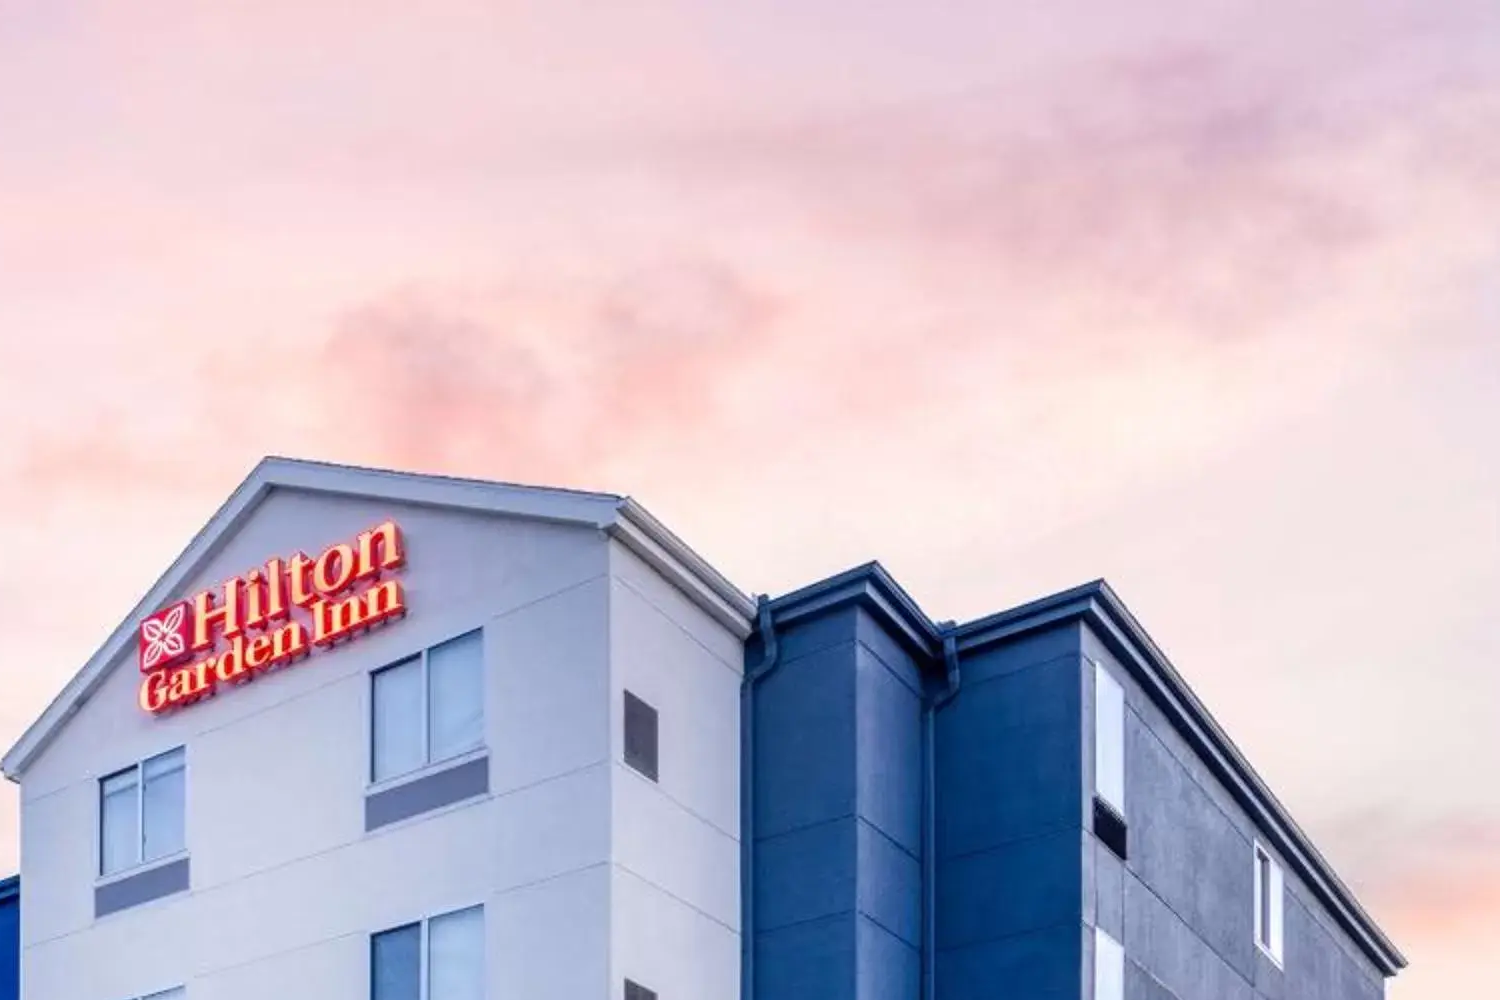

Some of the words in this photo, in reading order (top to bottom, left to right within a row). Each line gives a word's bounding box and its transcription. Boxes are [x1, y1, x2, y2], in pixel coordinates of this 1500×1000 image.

[139, 622, 309, 713] Garden
[311, 579, 404, 645] Inn
[190, 519, 404, 650] Hilton
